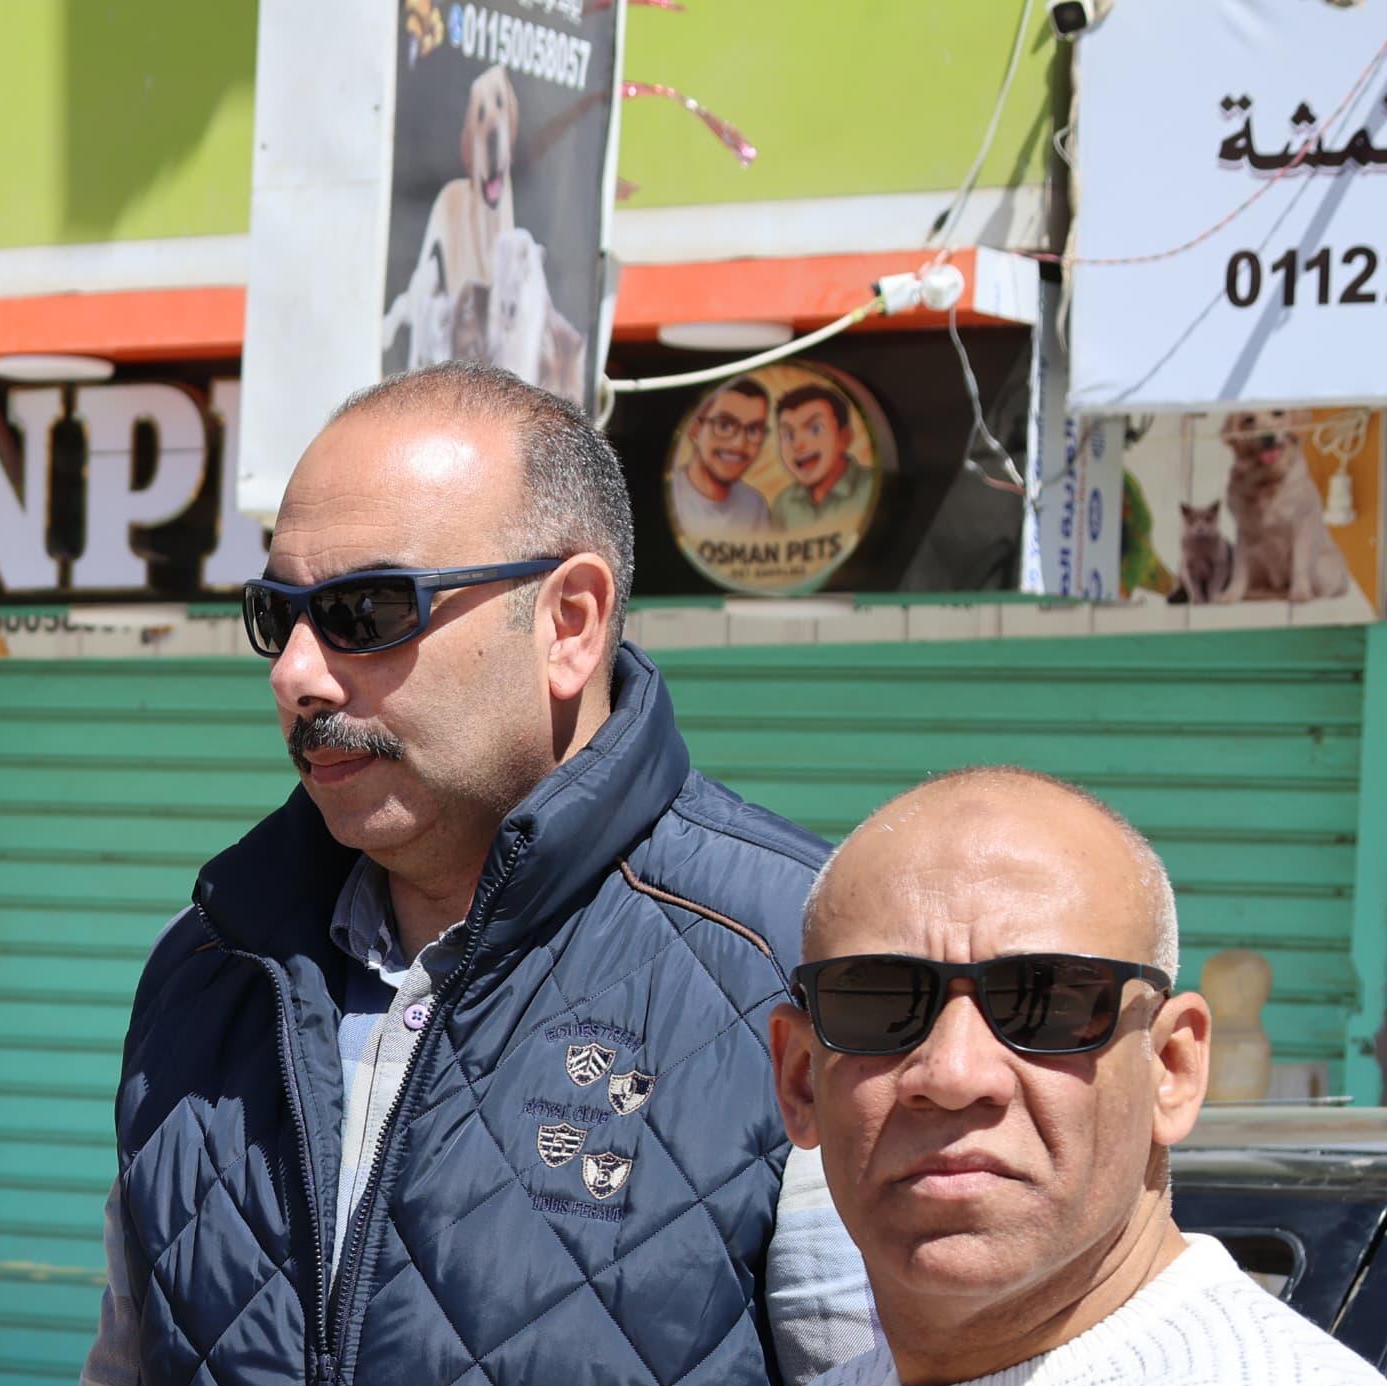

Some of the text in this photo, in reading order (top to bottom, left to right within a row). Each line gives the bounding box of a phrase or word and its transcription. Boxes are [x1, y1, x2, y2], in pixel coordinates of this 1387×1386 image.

[1216, 94, 1387, 170] مشة
[1226, 246, 1387, 308] 0112
[698, 531, 843, 565] OSMAN PETS
